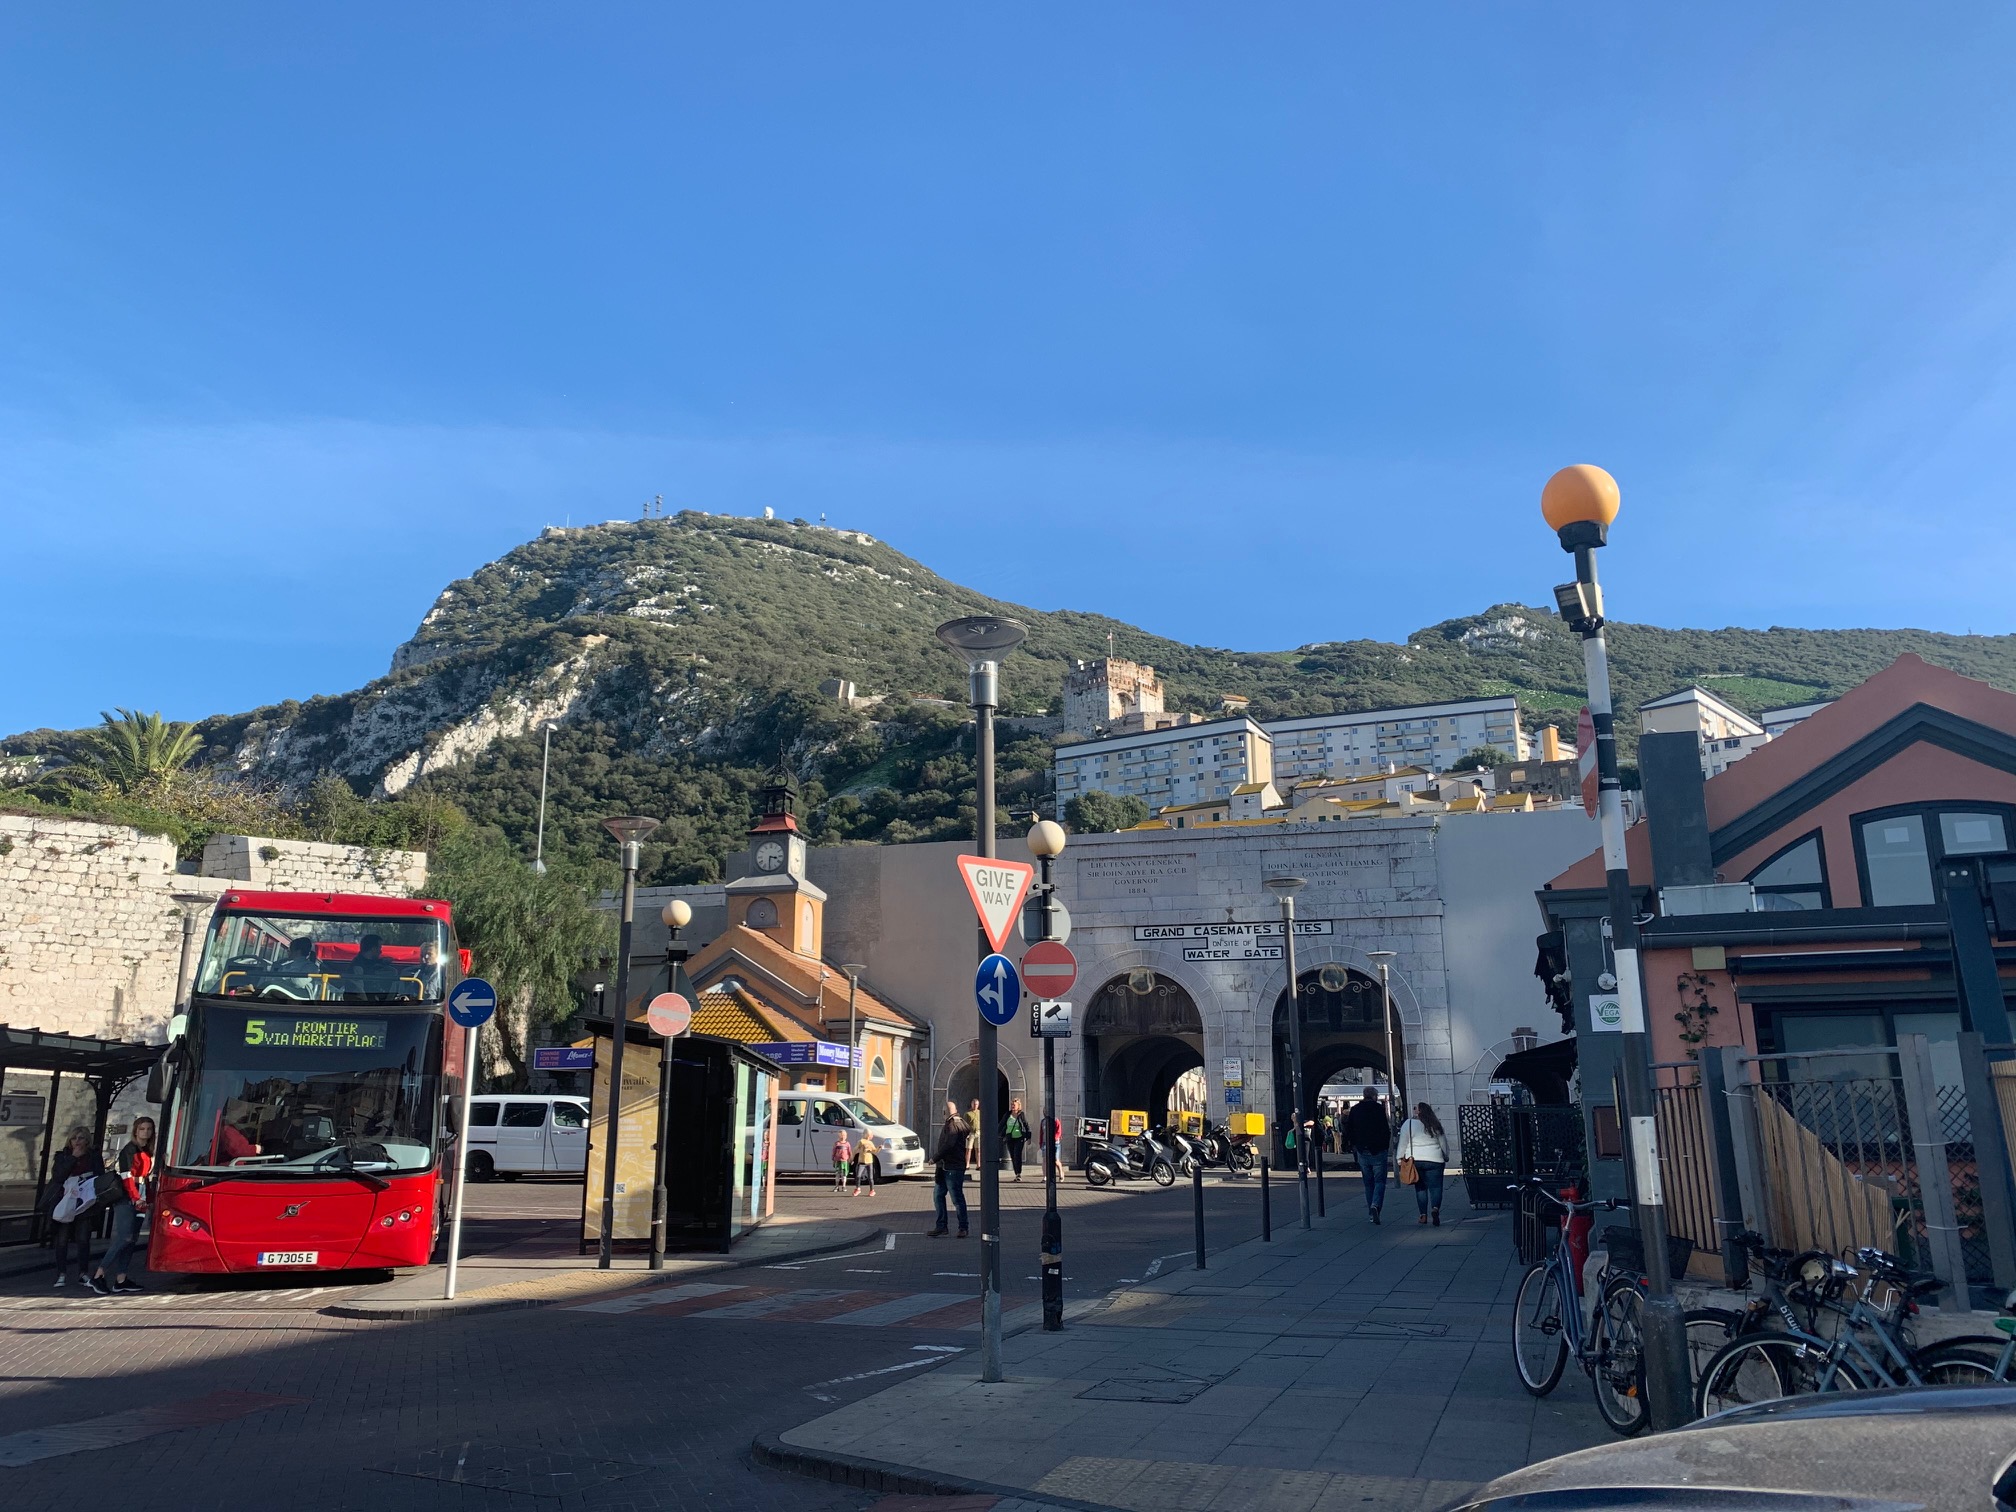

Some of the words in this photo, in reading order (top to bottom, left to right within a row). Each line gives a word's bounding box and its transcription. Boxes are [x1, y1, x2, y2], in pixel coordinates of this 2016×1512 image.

[1304, 851, 1344, 859] GENERAL
[1090, 860, 1141, 869] LIEUTENANT
[976, 868, 1015, 890] GIVE
[1301, 870, 1350, 878] GOVERNOR
[1114, 877, 1159, 886] GOVERNOR
[982, 890, 1012, 906] WAY
[1143, 927, 1185, 938] GRAND
[1193, 924, 1272, 937] CASEMATES
[1187, 949, 1230, 959] WATER
[1244, 949, 1279, 958] GATE
[245, 1020, 266, 1045] 5
[294, 1021, 359, 1035] FRONTIER
[264, 1032, 289, 1046] VIA
[291, 1033, 344, 1047] MARKET
[346, 1034, 385, 1048] PLACE
[0, 1099, 12, 1122] 5
[267, 1253, 275, 1264] G
[277, 1252, 304, 1264] 7305
[305, 1252, 313, 1263] E
